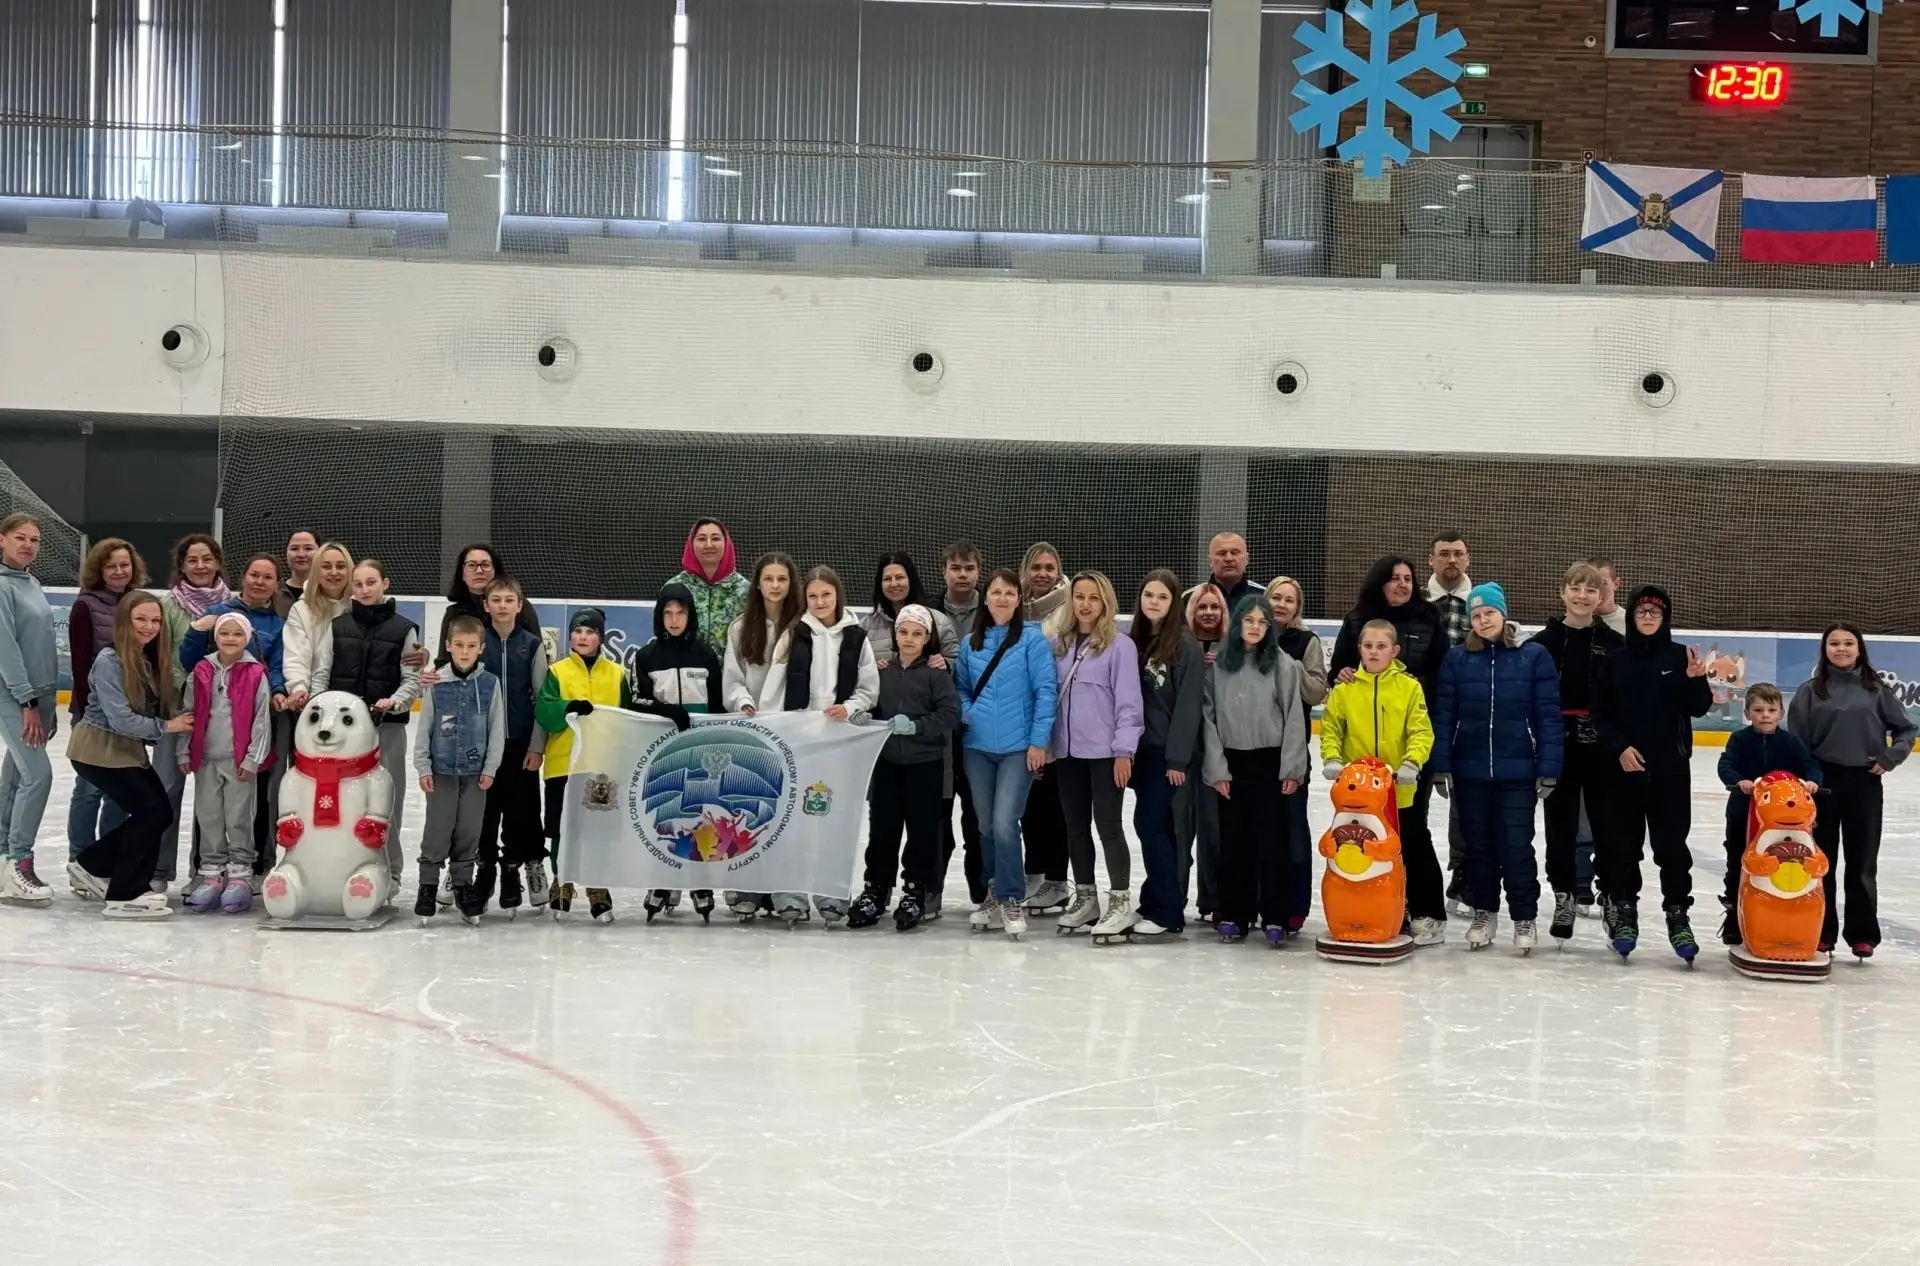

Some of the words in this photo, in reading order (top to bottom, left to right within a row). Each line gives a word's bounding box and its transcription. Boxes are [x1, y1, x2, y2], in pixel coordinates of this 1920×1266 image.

[1707, 65, 1782, 100] 12:30
[730, 720, 774, 738] ОБЛАСТИ
[636, 755, 648, 769] ПО
[776, 739, 798, 784] НЕНЕЦКОМУ
[630, 769, 641, 788] УФК
[628, 790, 639, 820] СОВЕТ
[761, 786, 798, 852] АВТОНОМНОМУ
[632, 821, 683, 869] МОЛОДЕЖНЫЙ
[727, 851, 760, 872] ОКРУГУ
